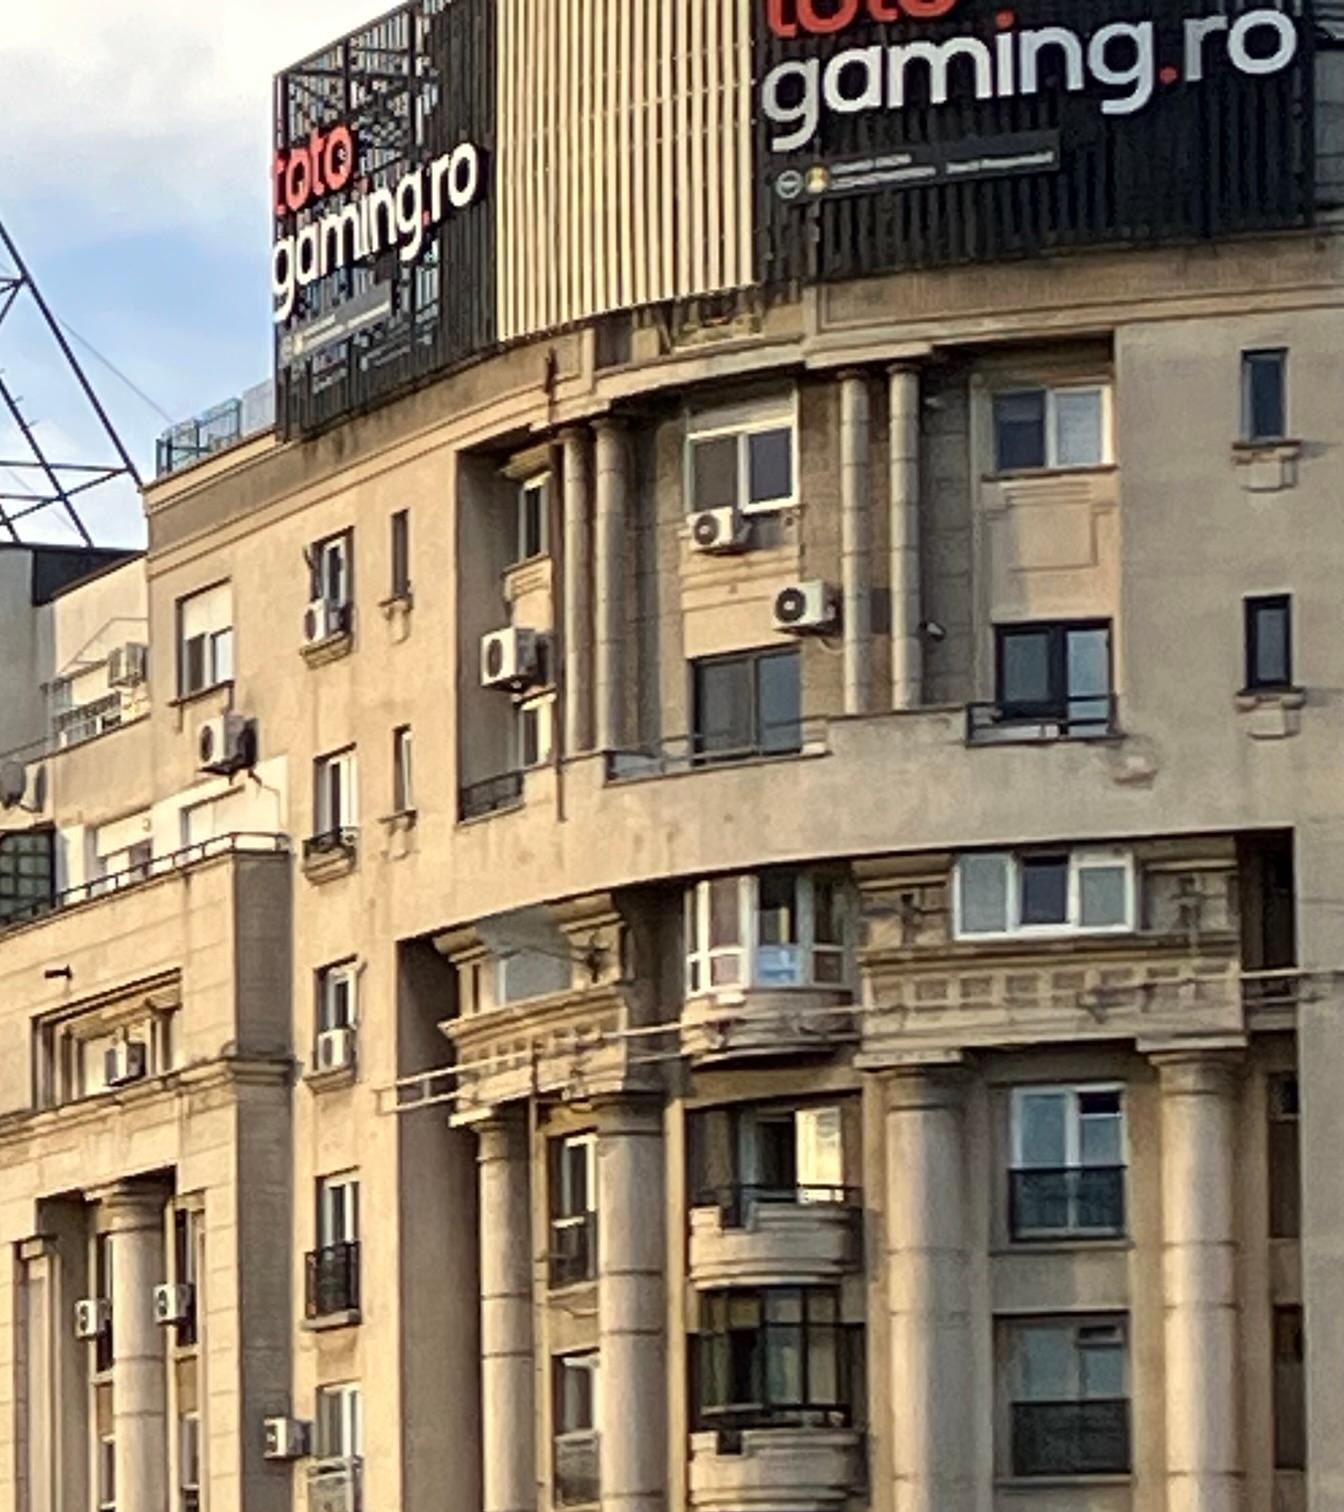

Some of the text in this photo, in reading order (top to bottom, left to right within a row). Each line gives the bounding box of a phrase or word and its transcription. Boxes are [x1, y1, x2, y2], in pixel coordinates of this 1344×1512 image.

[759, 7, 1300, 153] gaming.ro
[271, 141, 479, 322] gaming.ro
[273, 122, 354, 216] toto
